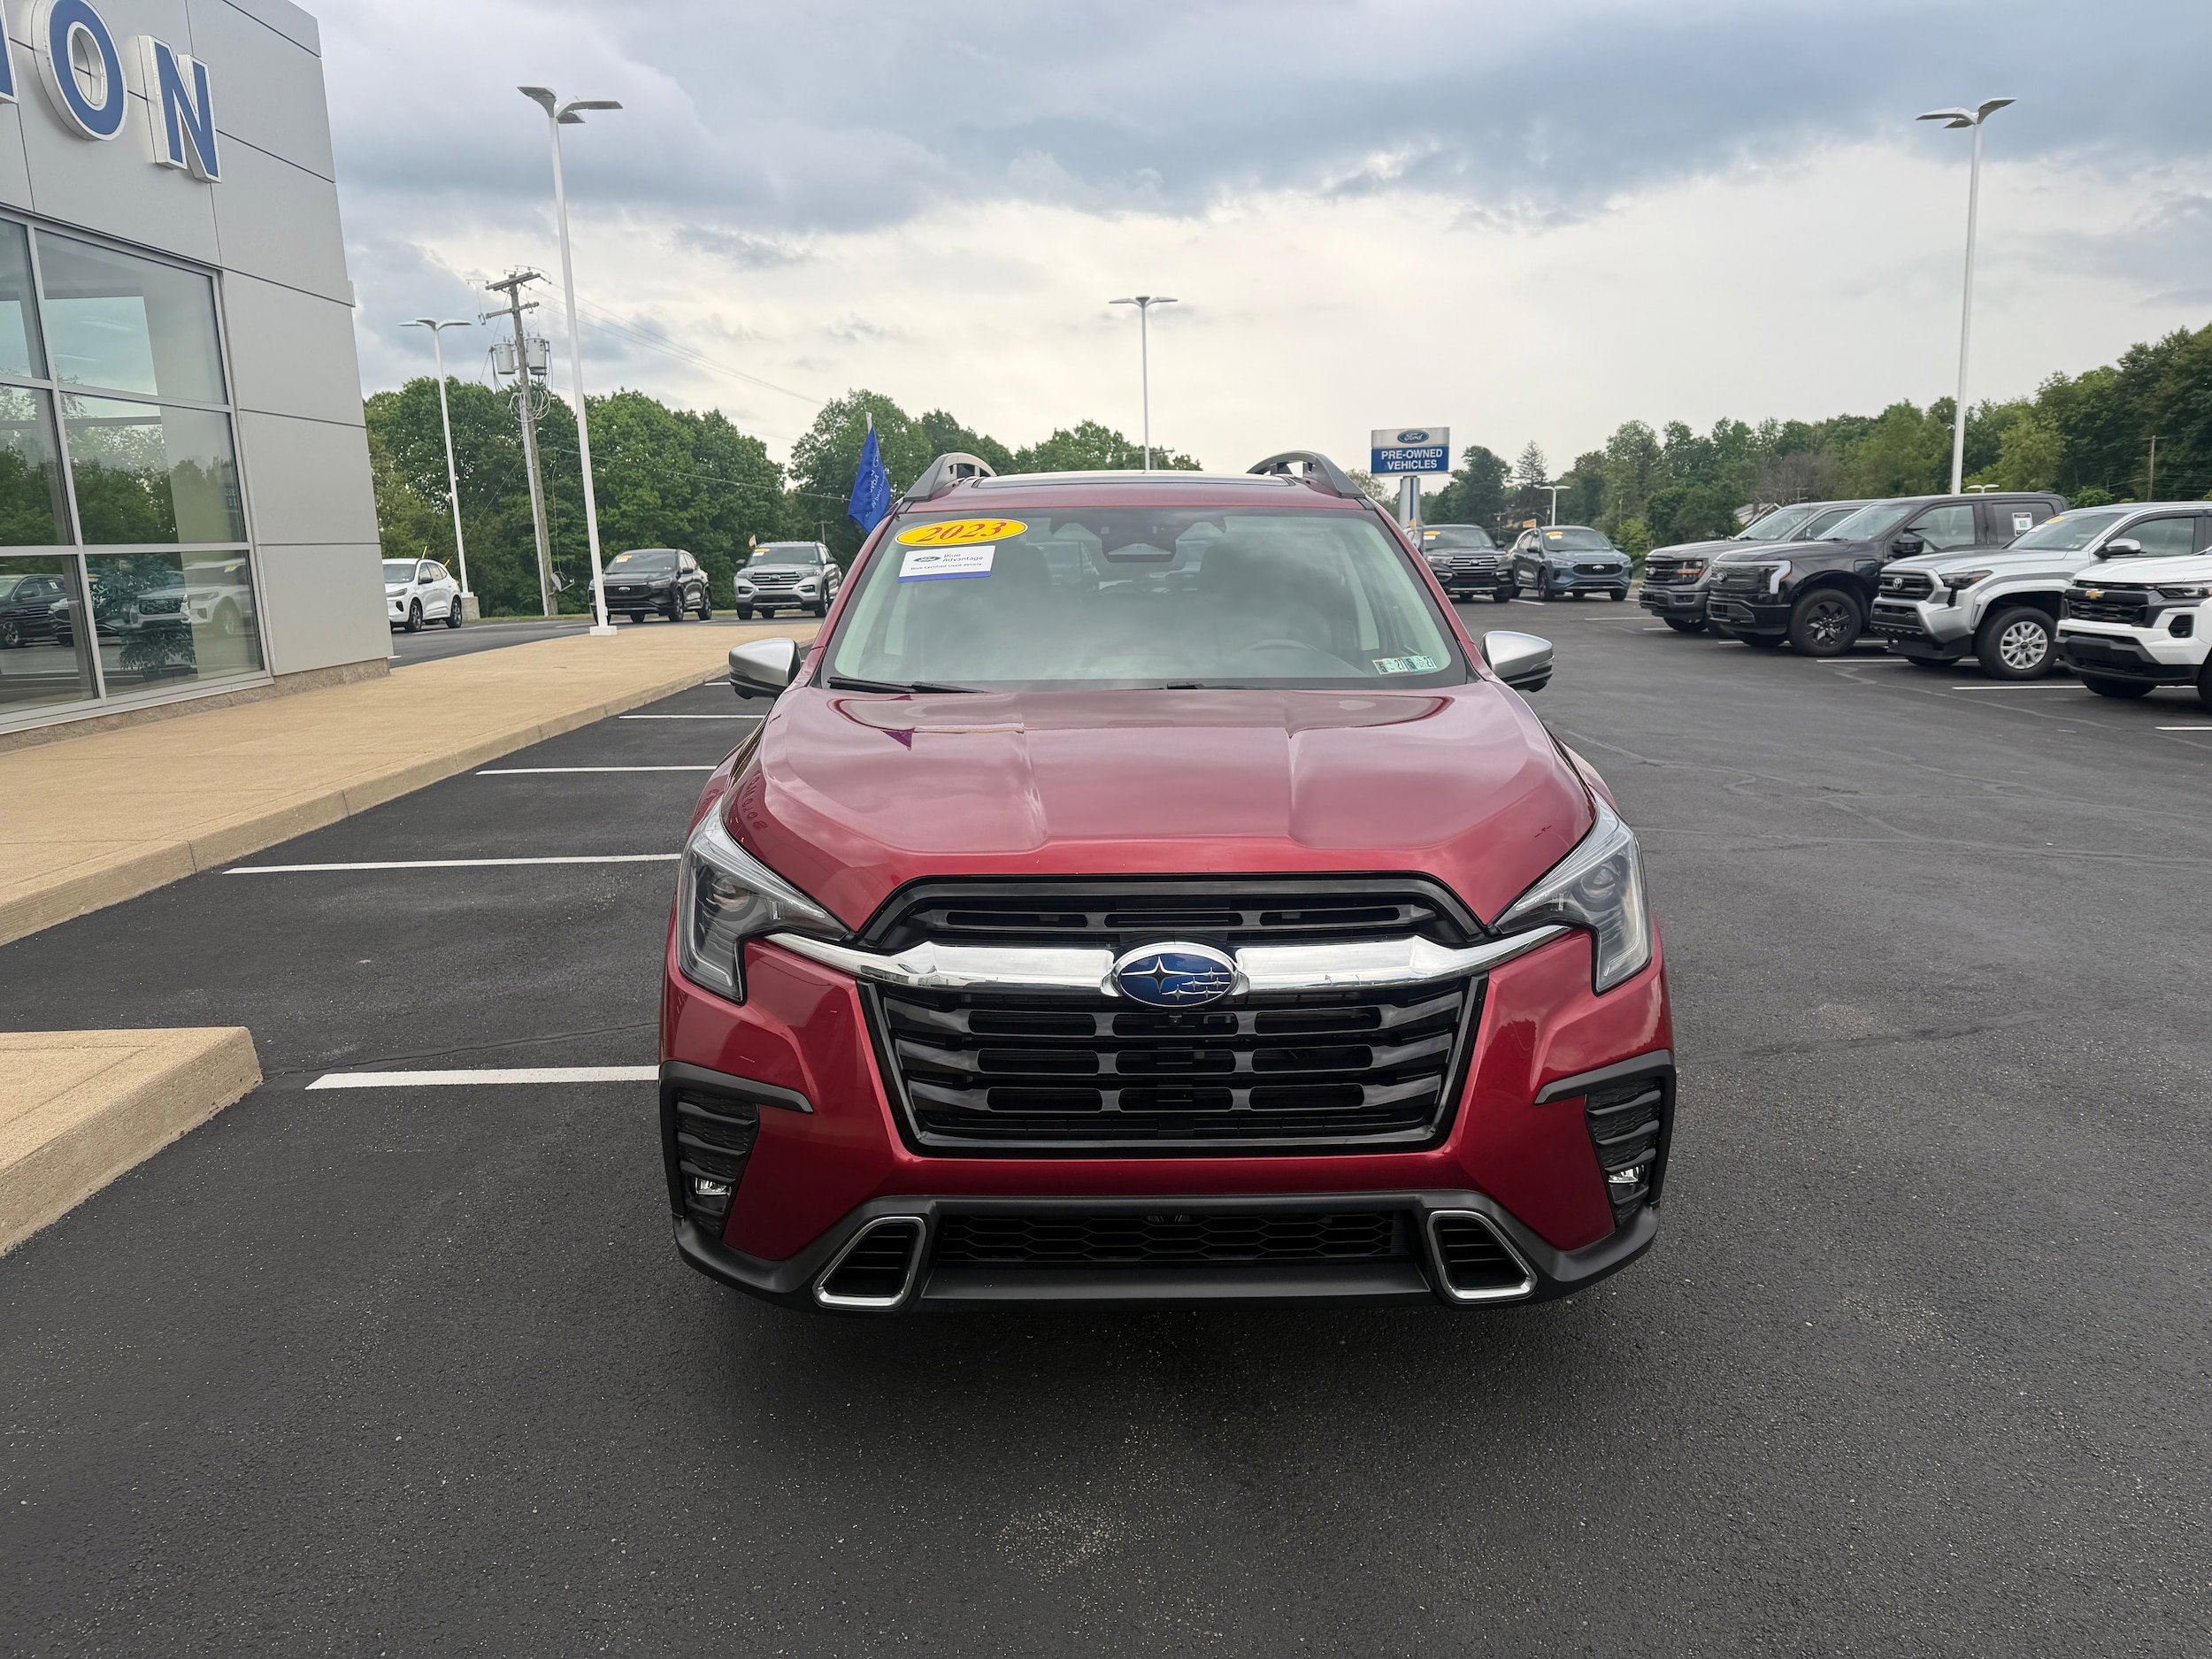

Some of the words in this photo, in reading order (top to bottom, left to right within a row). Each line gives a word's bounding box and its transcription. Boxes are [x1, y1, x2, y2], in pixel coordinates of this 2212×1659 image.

[1381, 449, 1443, 460] PRE-OWNED
[1387, 459, 1438, 471] VEHICLES
[916, 522, 1007, 542] 2023
